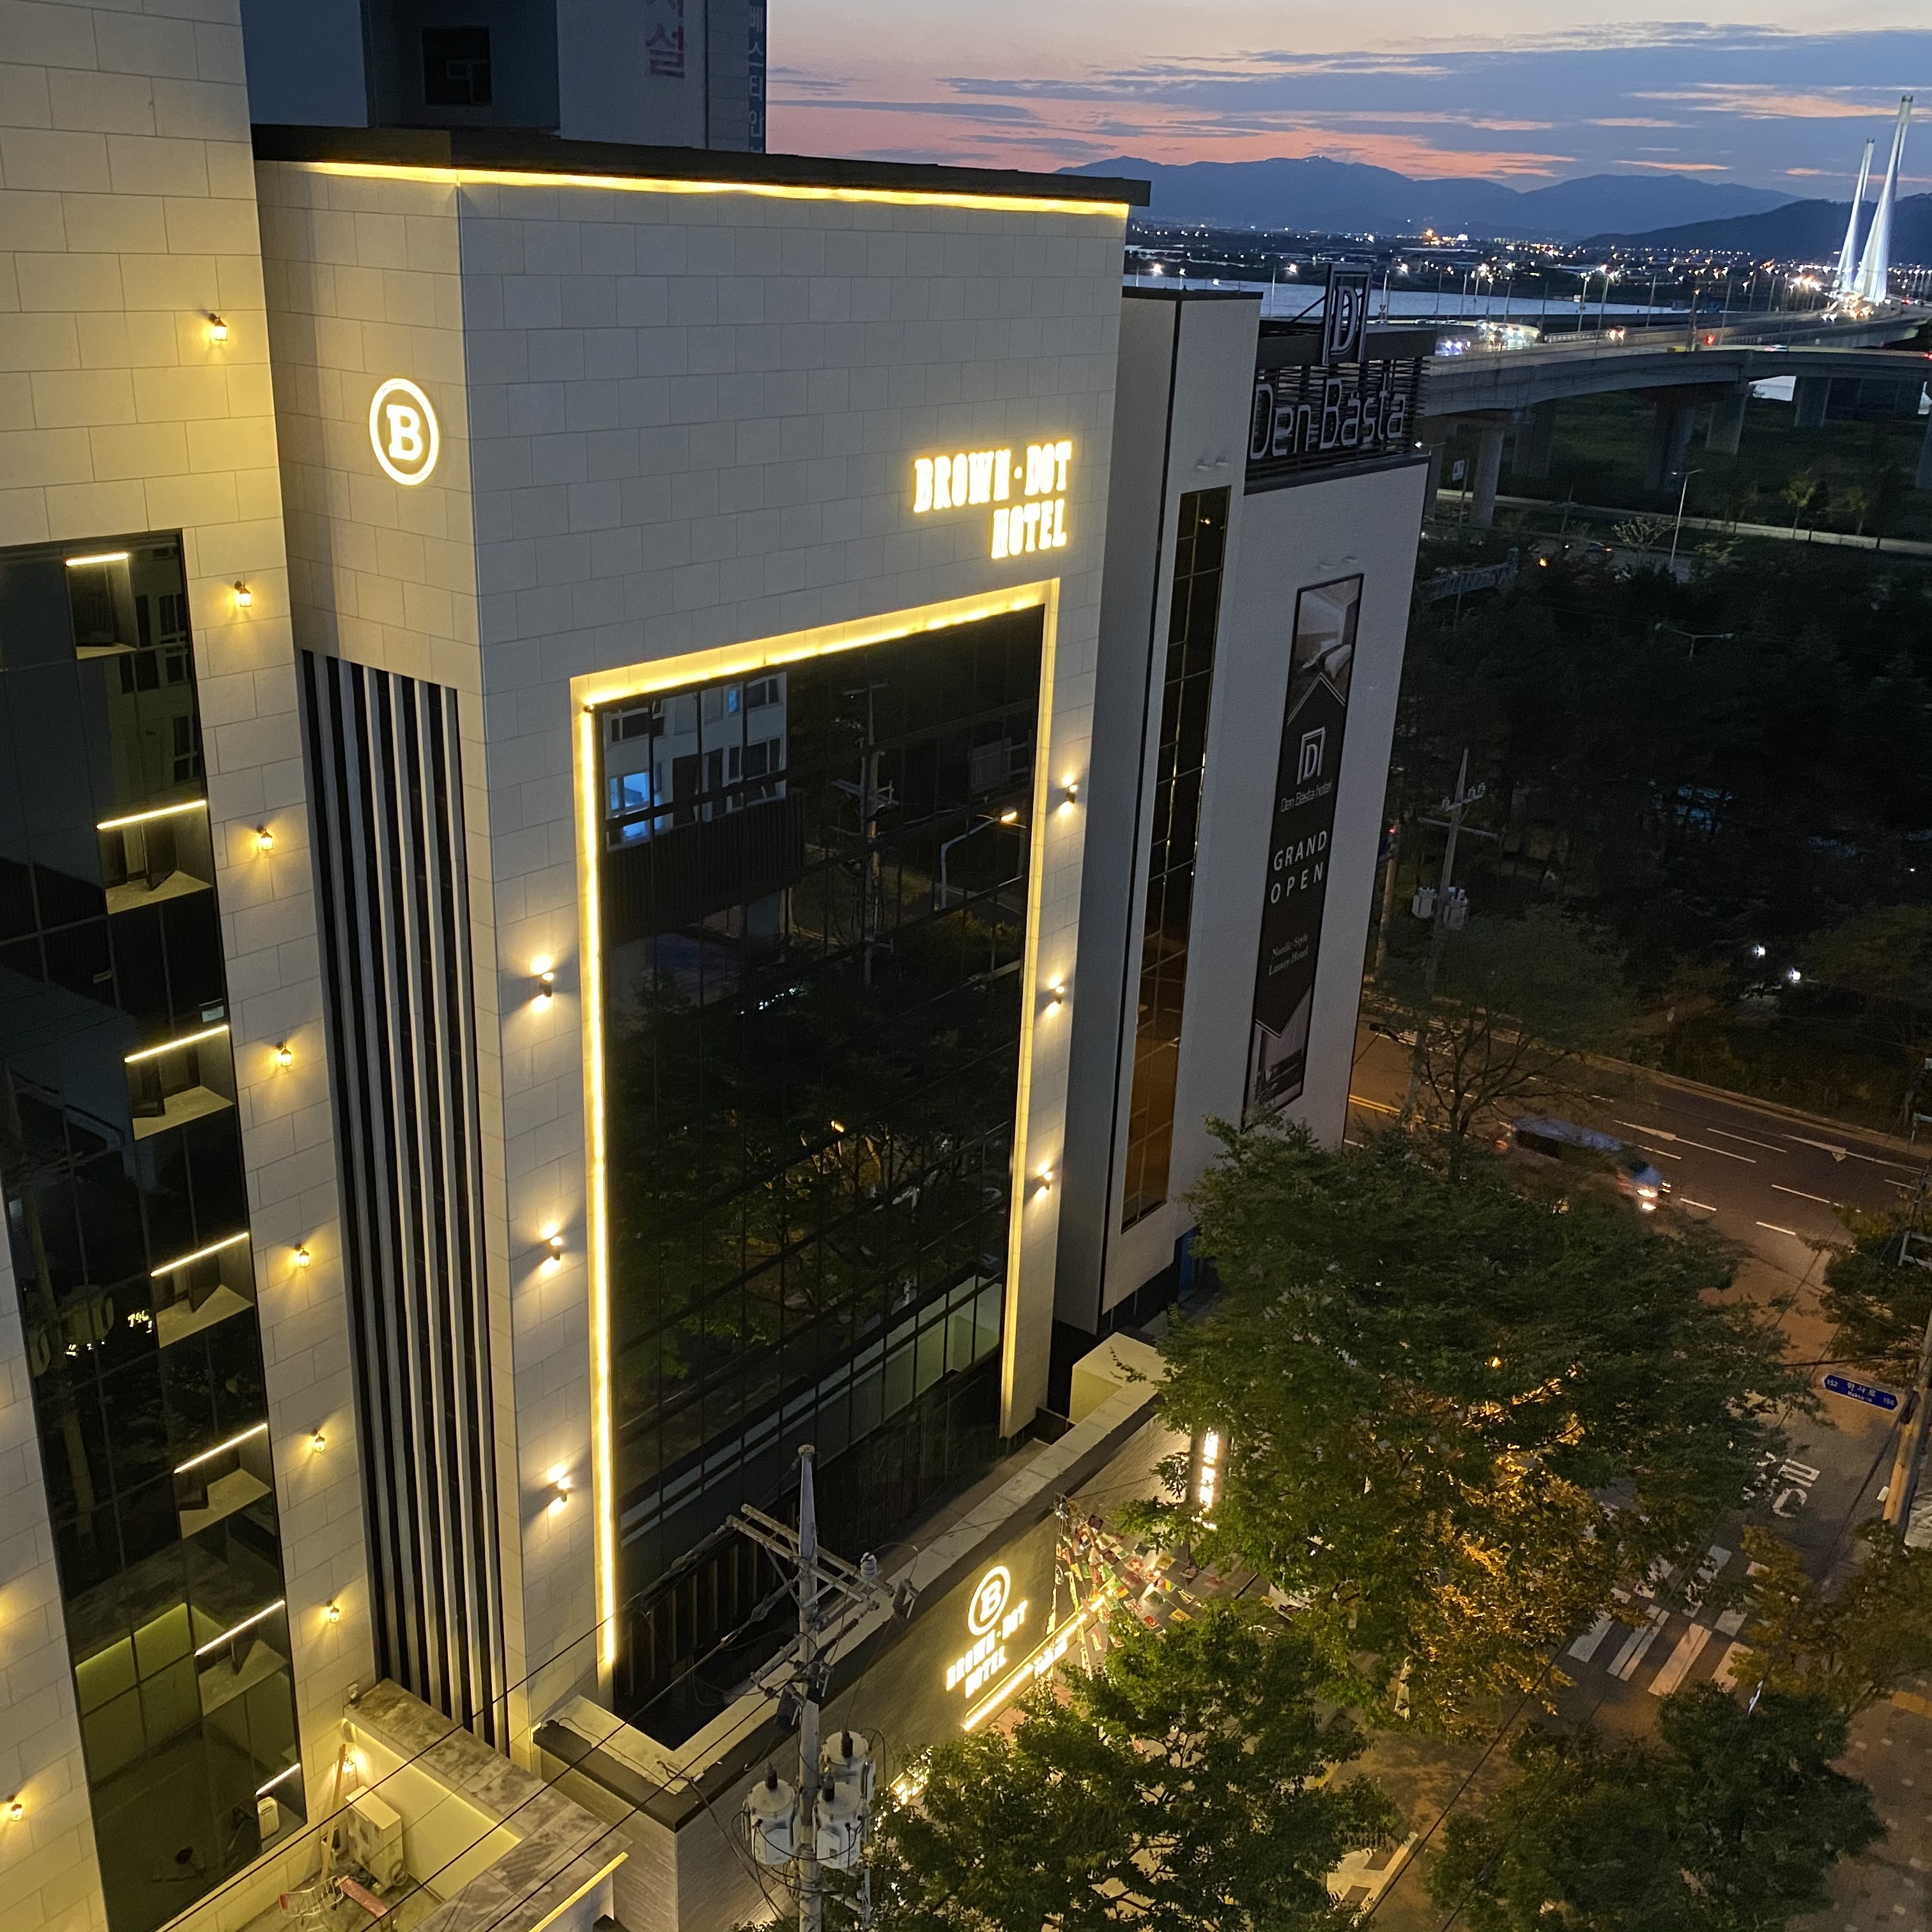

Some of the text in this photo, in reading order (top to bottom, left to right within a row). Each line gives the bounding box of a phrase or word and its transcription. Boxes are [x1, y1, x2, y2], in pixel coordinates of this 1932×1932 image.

[1330, 286, 1358, 355] D
[386, 404, 422, 461] B
[1250, 383, 1310, 459] Den
[991, 498, 1067, 559] HOTEL
[1273, 831, 1327, 871] GRAND
[1271, 862, 1323, 903] OPEN
[979, 1580, 1001, 1622] B
[965, 1645, 1007, 1699] HOTEL
